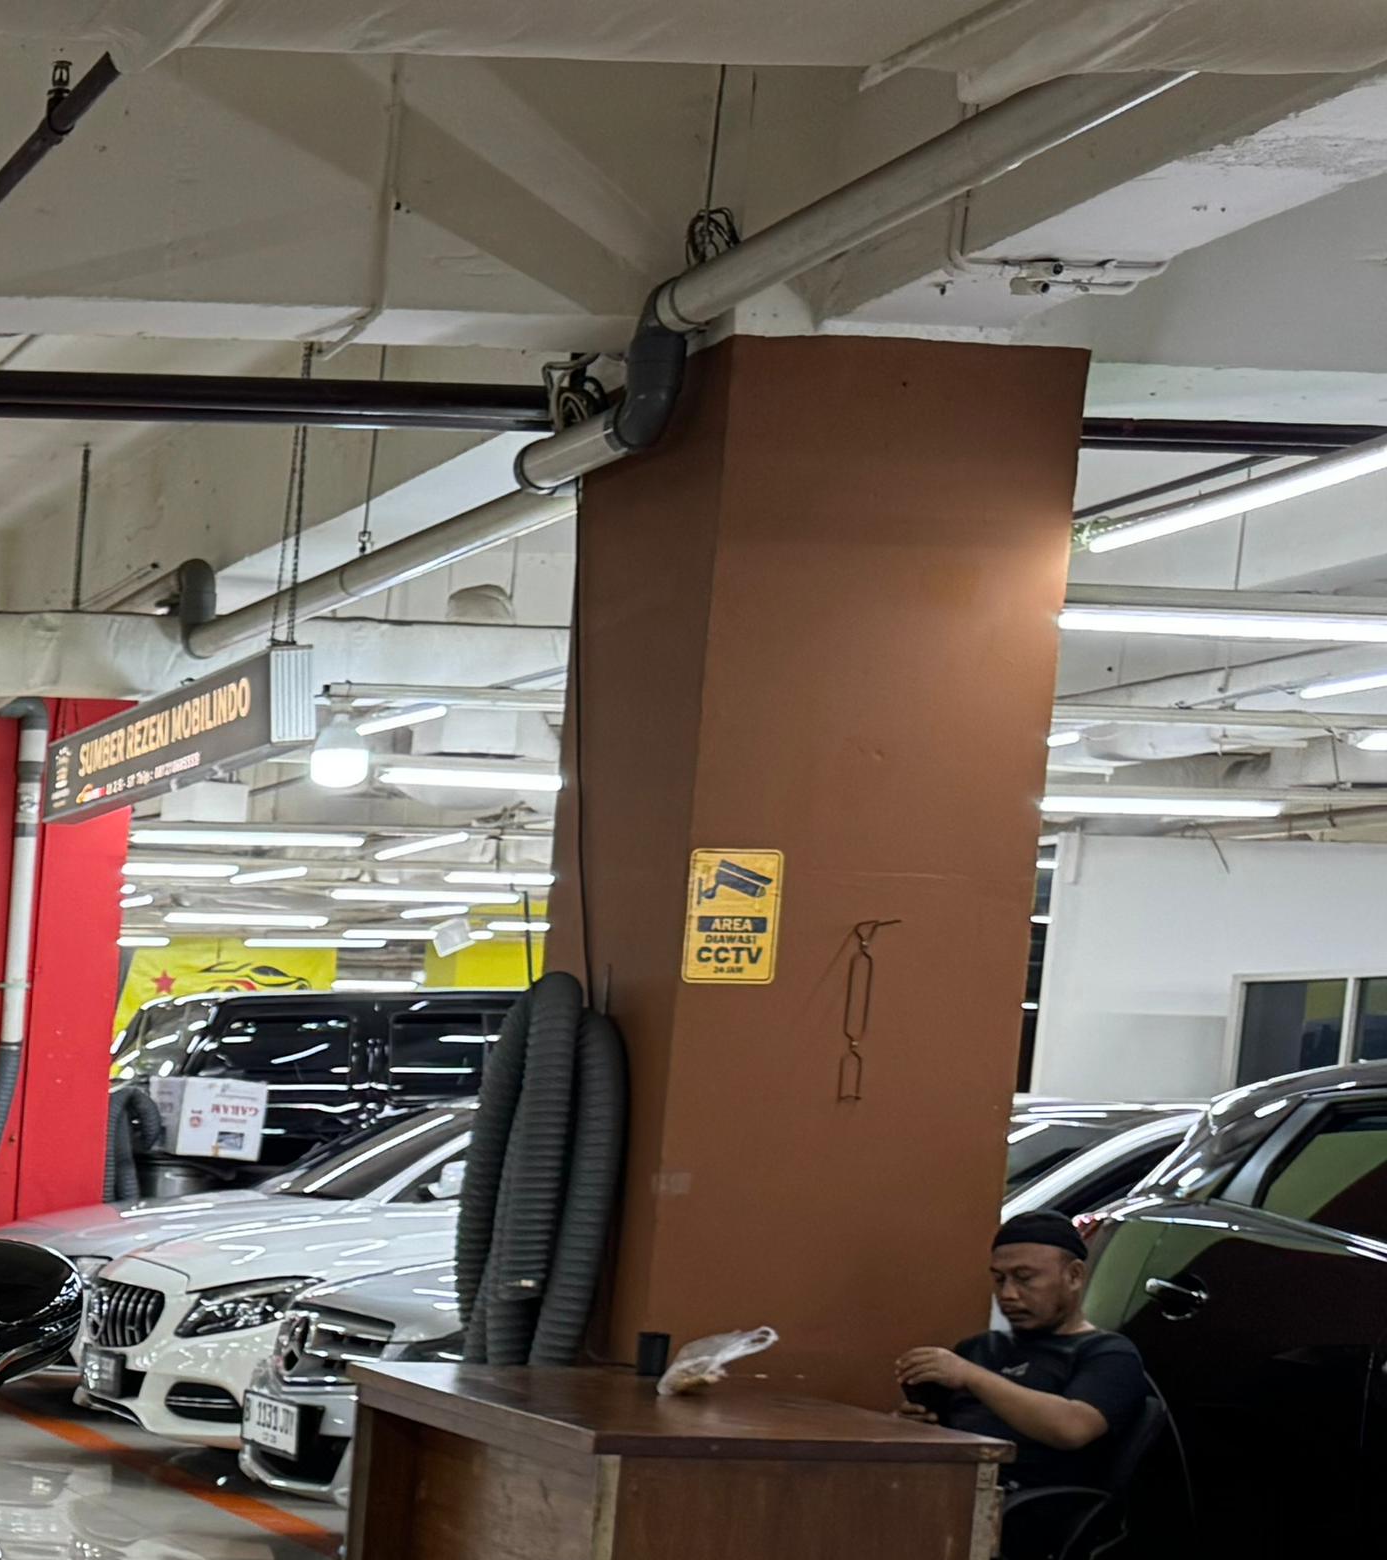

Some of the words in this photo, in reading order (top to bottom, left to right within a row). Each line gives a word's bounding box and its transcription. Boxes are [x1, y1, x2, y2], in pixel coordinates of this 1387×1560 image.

[78, 729, 126, 777] SUMBER
[126, 710, 170, 760] REZEKI
[171, 677, 251, 744] MOBILINDO
[710, 918, 753, 931] AREA
[705, 934, 757, 944] DIAWASI
[696, 946, 763, 964] CCTV
